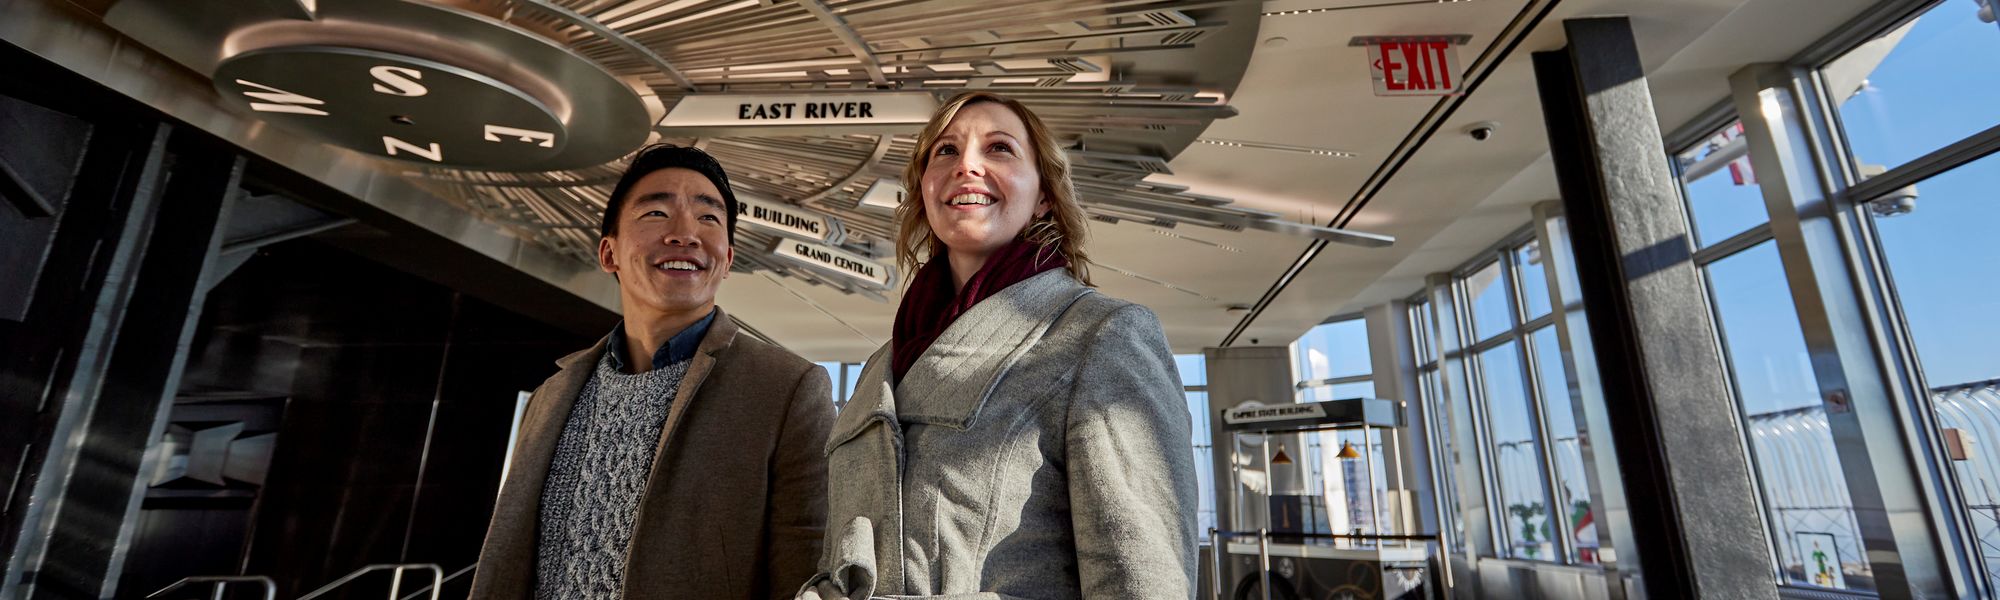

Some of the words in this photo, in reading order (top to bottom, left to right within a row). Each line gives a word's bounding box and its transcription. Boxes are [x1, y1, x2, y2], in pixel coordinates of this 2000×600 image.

[1380, 41, 1452, 90] EXIT
[369, 66, 428, 97] S
[235, 78, 330, 116] W
[738, 102, 796, 120] EAST
[804, 102, 873, 119] RIVER
[484, 124, 555, 148] E
[753, 205, 819, 234] BUILDING
[795, 244, 831, 263] GRAND
[834, 256, 875, 277] CENTRAL
[1232, 410, 1256, 420] EMPIRE
[1258, 408, 1277, 417] STATE
[1279, 406, 1314, 416] BUILDING
